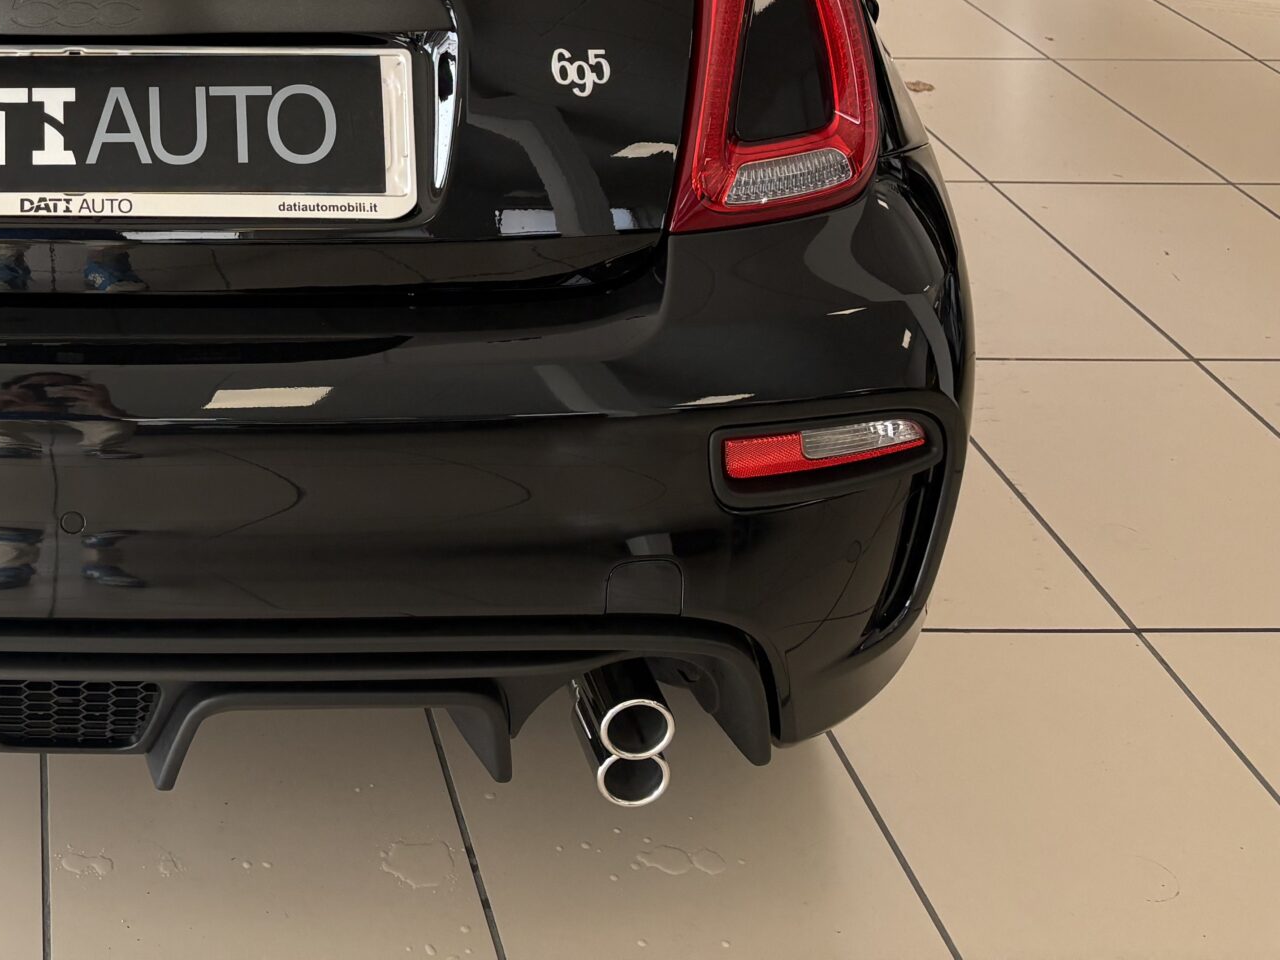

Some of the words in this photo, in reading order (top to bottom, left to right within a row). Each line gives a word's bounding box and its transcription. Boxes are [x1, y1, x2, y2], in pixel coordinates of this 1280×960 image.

[551, 48, 611, 97] 695
[85, 83, 337, 165] AUTO
[20, 197, 73, 213] DATI
[78, 198, 133, 213] AUTO
[278, 201, 378, 212] datiautomobili.it
